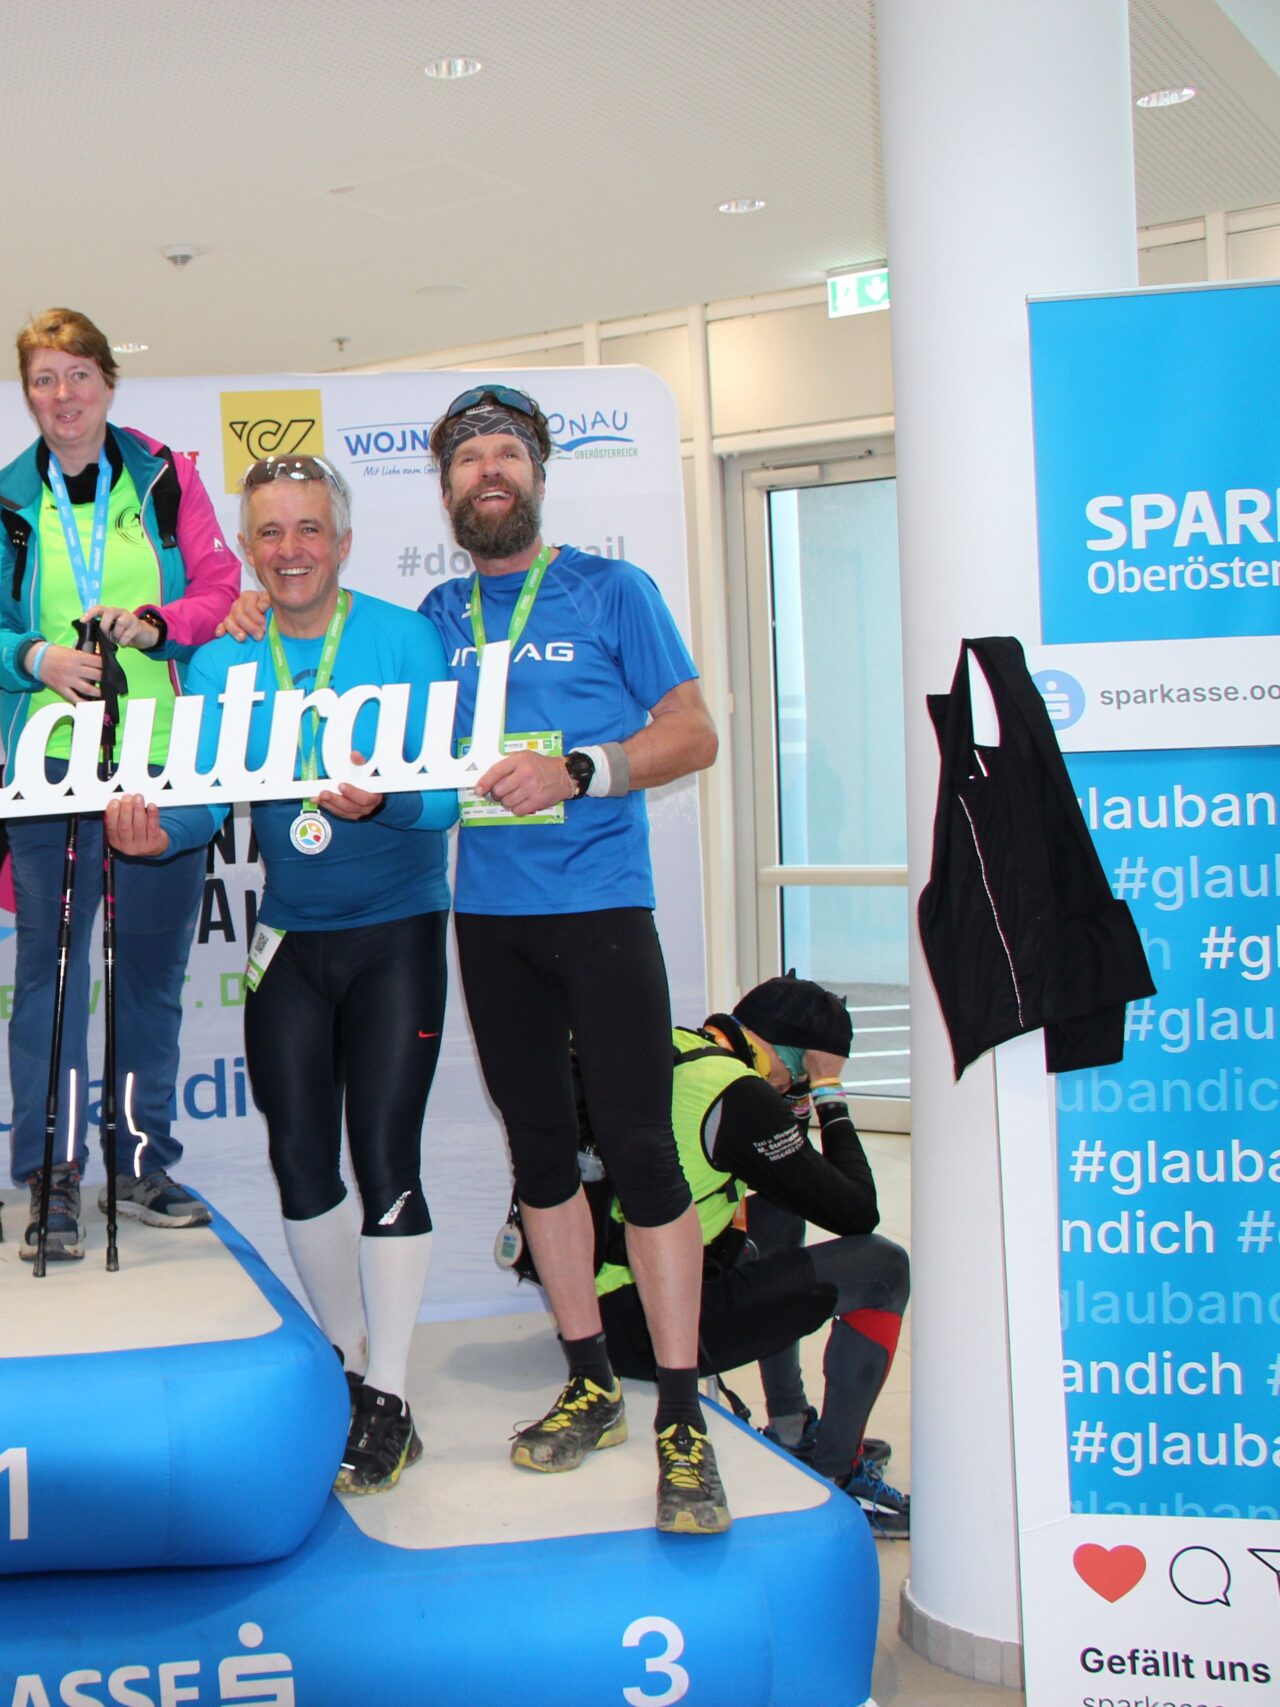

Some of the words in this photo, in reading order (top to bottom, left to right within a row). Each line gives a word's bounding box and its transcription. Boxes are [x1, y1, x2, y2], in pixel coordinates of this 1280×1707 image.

[343, 429, 429, 457] WOJN
[547, 409, 628, 437] ONAU
[574, 447, 638, 460] OBERÖSTERREICH
[1084, 487, 1280, 552] SPAR
[1080, 784, 1276, 831] lauban
[1112, 854, 1280, 912] #glau
[1070, 1420, 1280, 1477] #glaub
[620, 1615, 689, 1704] 3
[1079, 1646, 1196, 1680] Gefällt
[1204, 1658, 1272, 1684] uns
